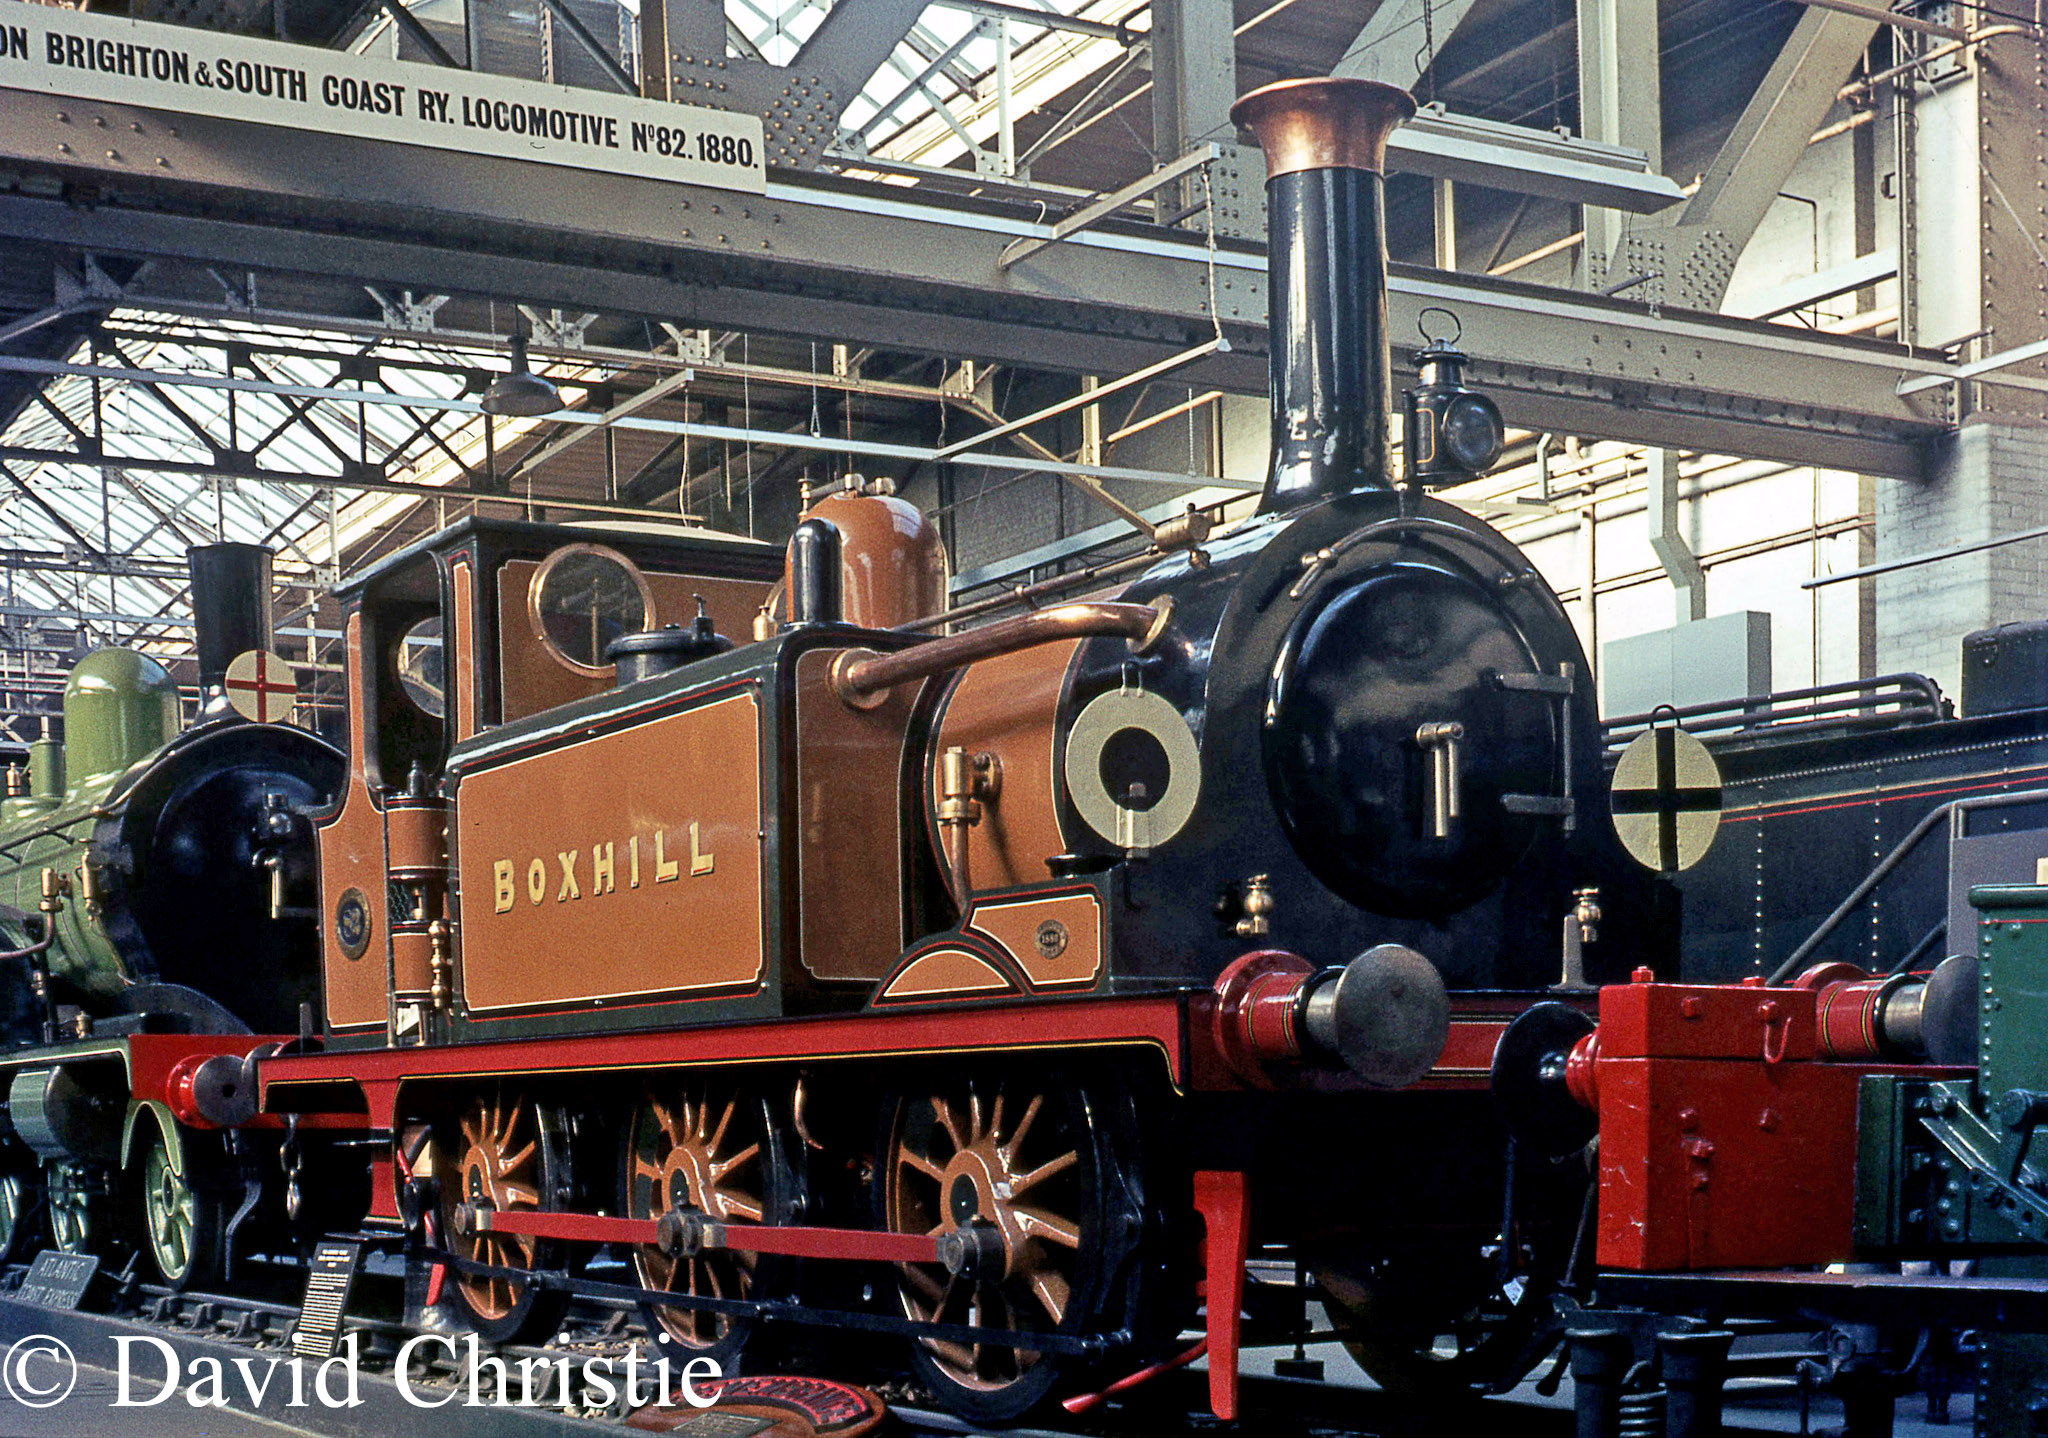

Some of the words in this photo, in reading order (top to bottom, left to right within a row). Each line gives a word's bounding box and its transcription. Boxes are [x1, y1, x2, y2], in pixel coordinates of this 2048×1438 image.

[45, 31, 189, 84] BRIGHTON
[215, 58, 307, 102] SOUTH
[322, 75, 405, 117] COAST
[418, 89, 455, 124] RY.
[462, 97, 619, 148] LOCOMOTIVE
[494, 822, 714, 913] BOXHILL
